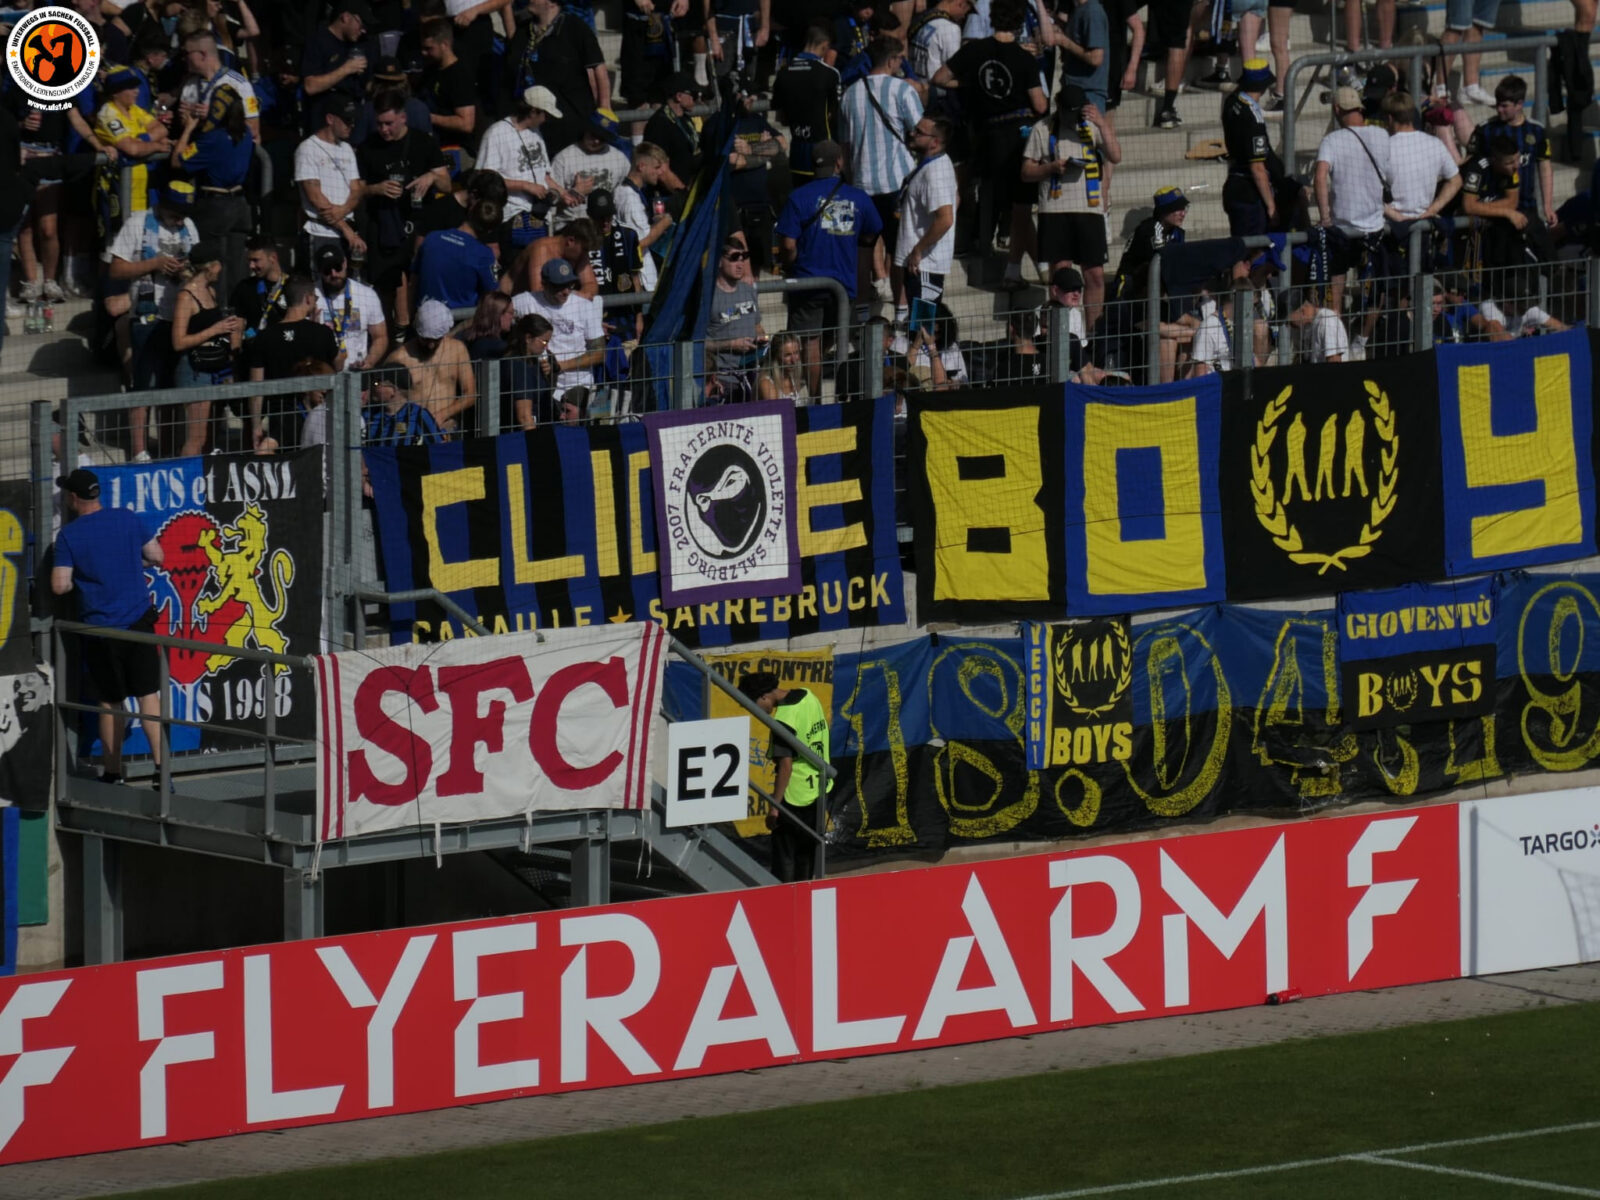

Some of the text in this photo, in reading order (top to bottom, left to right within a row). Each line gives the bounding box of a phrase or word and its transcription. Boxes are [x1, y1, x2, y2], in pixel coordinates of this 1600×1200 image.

[110, 461, 297, 513] 1.FCS et ASNL
[757, 442, 784, 543] VIOLETTE
[668, 503, 690, 550] 2007
[688, 544, 768, 581] SALZBURG
[650, 572, 892, 630] SARREBRUCK
[1346, 594, 1491, 639] GIOVENTÙ
[224, 677, 293, 721] 1998
[1030, 623, 1042, 767] VECCHI
[348, 655, 629, 807] SFC
[1052, 721, 1133, 765] BOYS
[677, 743, 741, 802] E2
[137, 832, 1290, 1139] FLYERALARM
